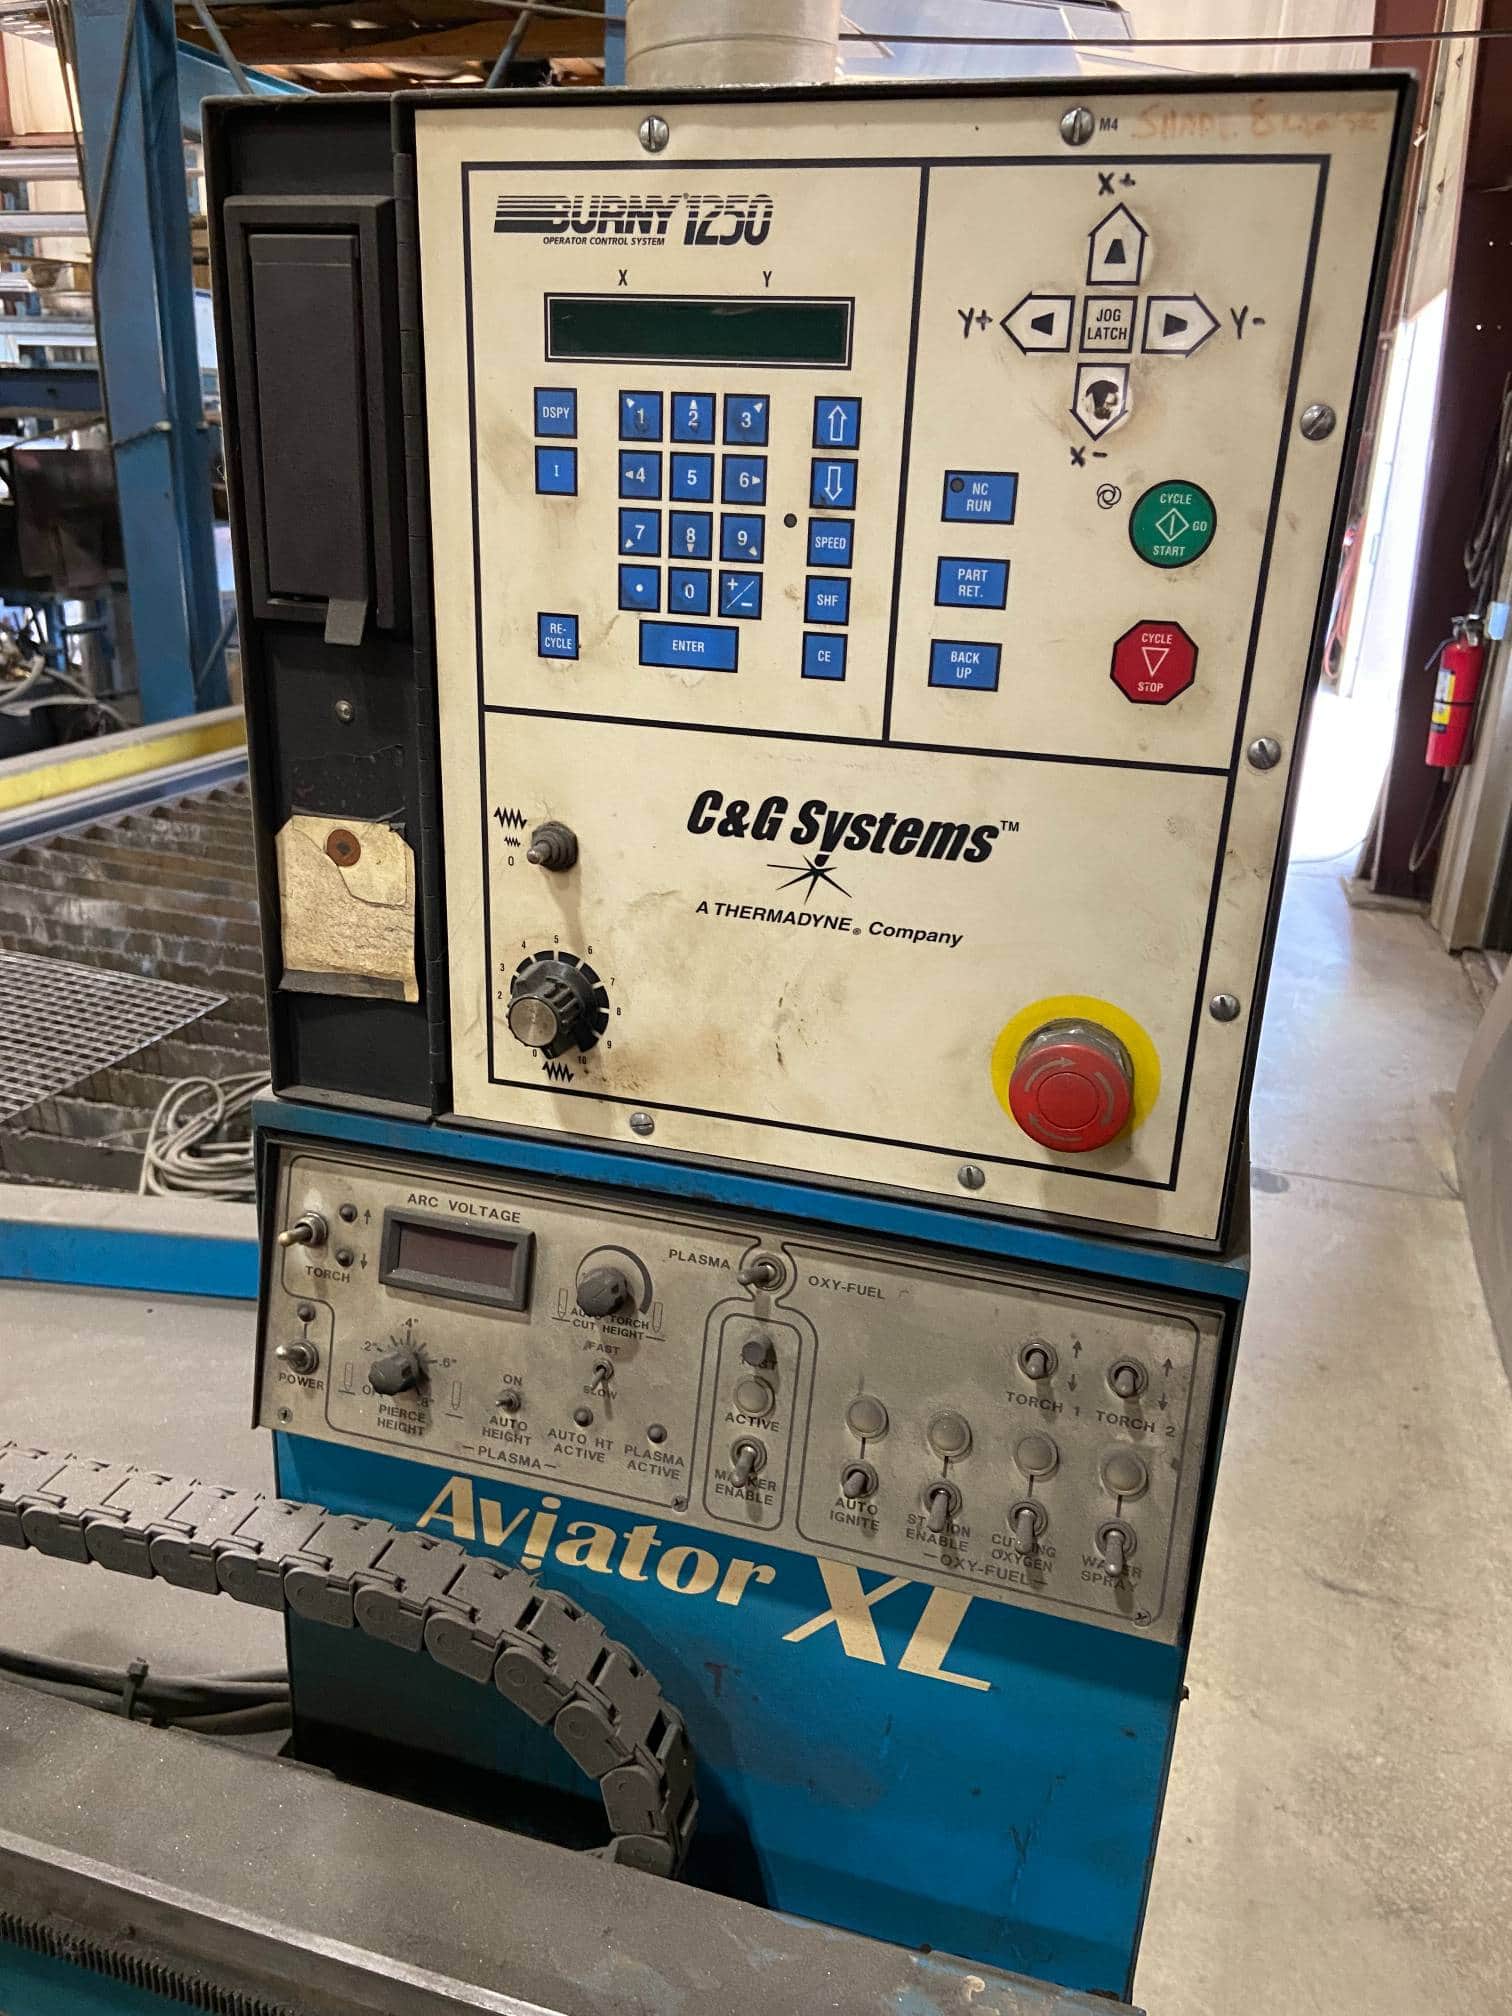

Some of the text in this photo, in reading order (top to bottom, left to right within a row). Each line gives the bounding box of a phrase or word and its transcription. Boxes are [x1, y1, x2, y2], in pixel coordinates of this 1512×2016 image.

[1099, 117, 1119, 131] M4
[494, 194, 774, 246] BURNY 1250
[543, 236, 665, 246] OPERATOR CONTROL SYSTEM
[618, 269, 628, 286] X
[762, 270, 773, 288] Y
[1095, 308, 1122, 322] JOG
[1087, 327, 1128, 341] LATCH
[542, 406, 570, 420] DSPY
[636, 409, 646, 425] 1
[688, 410, 699, 427] 2
[741, 411, 752, 429] 3
[635, 467, 646, 483] 4
[687, 469, 698, 486] 5
[739, 472, 750, 488] 6
[972, 482, 989, 496] NC
[966, 498, 992, 513] RUN
[1159, 493, 1192, 505] CYCLE
[635, 525, 646, 541] 7
[1192, 520, 1208, 532] GO
[686, 527, 697, 544] 8
[737, 530, 748, 547] 9
[814, 535, 847, 551] SPEED
[1152, 545, 1185, 557] START
[957, 568, 988, 582] PART
[684, 583, 695, 600] 0
[958, 584, 984, 598] RET.
[816, 593, 839, 608] SHF
[550, 623, 567, 634] RE-
[544, 637, 573, 649] CYCLE
[672, 640, 705, 653] ENTER
[1141, 633, 1173, 645] CYCLE
[817, 649, 832, 663] CE
[950, 650, 981, 664] BACK
[956, 668, 973, 680] UP
[1137, 681, 1164, 693] STOP
[687, 789, 789, 842] C&G
[790, 799, 1000, 868] Systems
[695, 900, 710, 914] A
[868, 921, 964, 948] Company
[407, 1192, 521, 1224] ARC VOLTAGE
[668, 1249, 731, 1270] PLASMA
[304, 1265, 351, 1283] TORCH
[808, 1275, 886, 1300] OXY-FUEL
[573, 1319, 645, 1341] CUT HEIGHT
[611, 1314, 650, 1330] TORCH
[278, 1371, 324, 1390] POWER
[503, 1374, 522, 1386] ON
[1006, 1391, 1081, 1417] TORCH 1
[379, 1404, 426, 1423] PIERCE
[725, 1412, 780, 1432] ACTIVE
[377, 1417, 425, 1436] HEIGHT
[489, 1415, 528, 1432] AUTO
[1096, 1410, 1176, 1438] TORCH 2
[482, 1427, 532, 1446] HEIGHT
[548, 1427, 614, 1451] AUTO HT
[478, 1445, 541, 1470] PLASMA
[553, 1443, 606, 1463] ACTIVE
[624, 1443, 685, 1467] PLASMA
[627, 1459, 681, 1480] ACTIVE
[714, 1468, 777, 1492] MKER
[715, 1483, 774, 1506] ENABLE
[834, 1498, 879, 1516] AUTO
[829, 1511, 881, 1532] IGNITE
[906, 1513, 971, 1538] STION
[905, 1528, 969, 1552] ENABLE
[940, 1553, 1028, 1586] OXY-FUEL
[991, 1549, 1053, 1573] OXYGEN
[416, 1476, 992, 1692] Aviator XL
[1080, 1570, 1139, 1593] SPRAY
